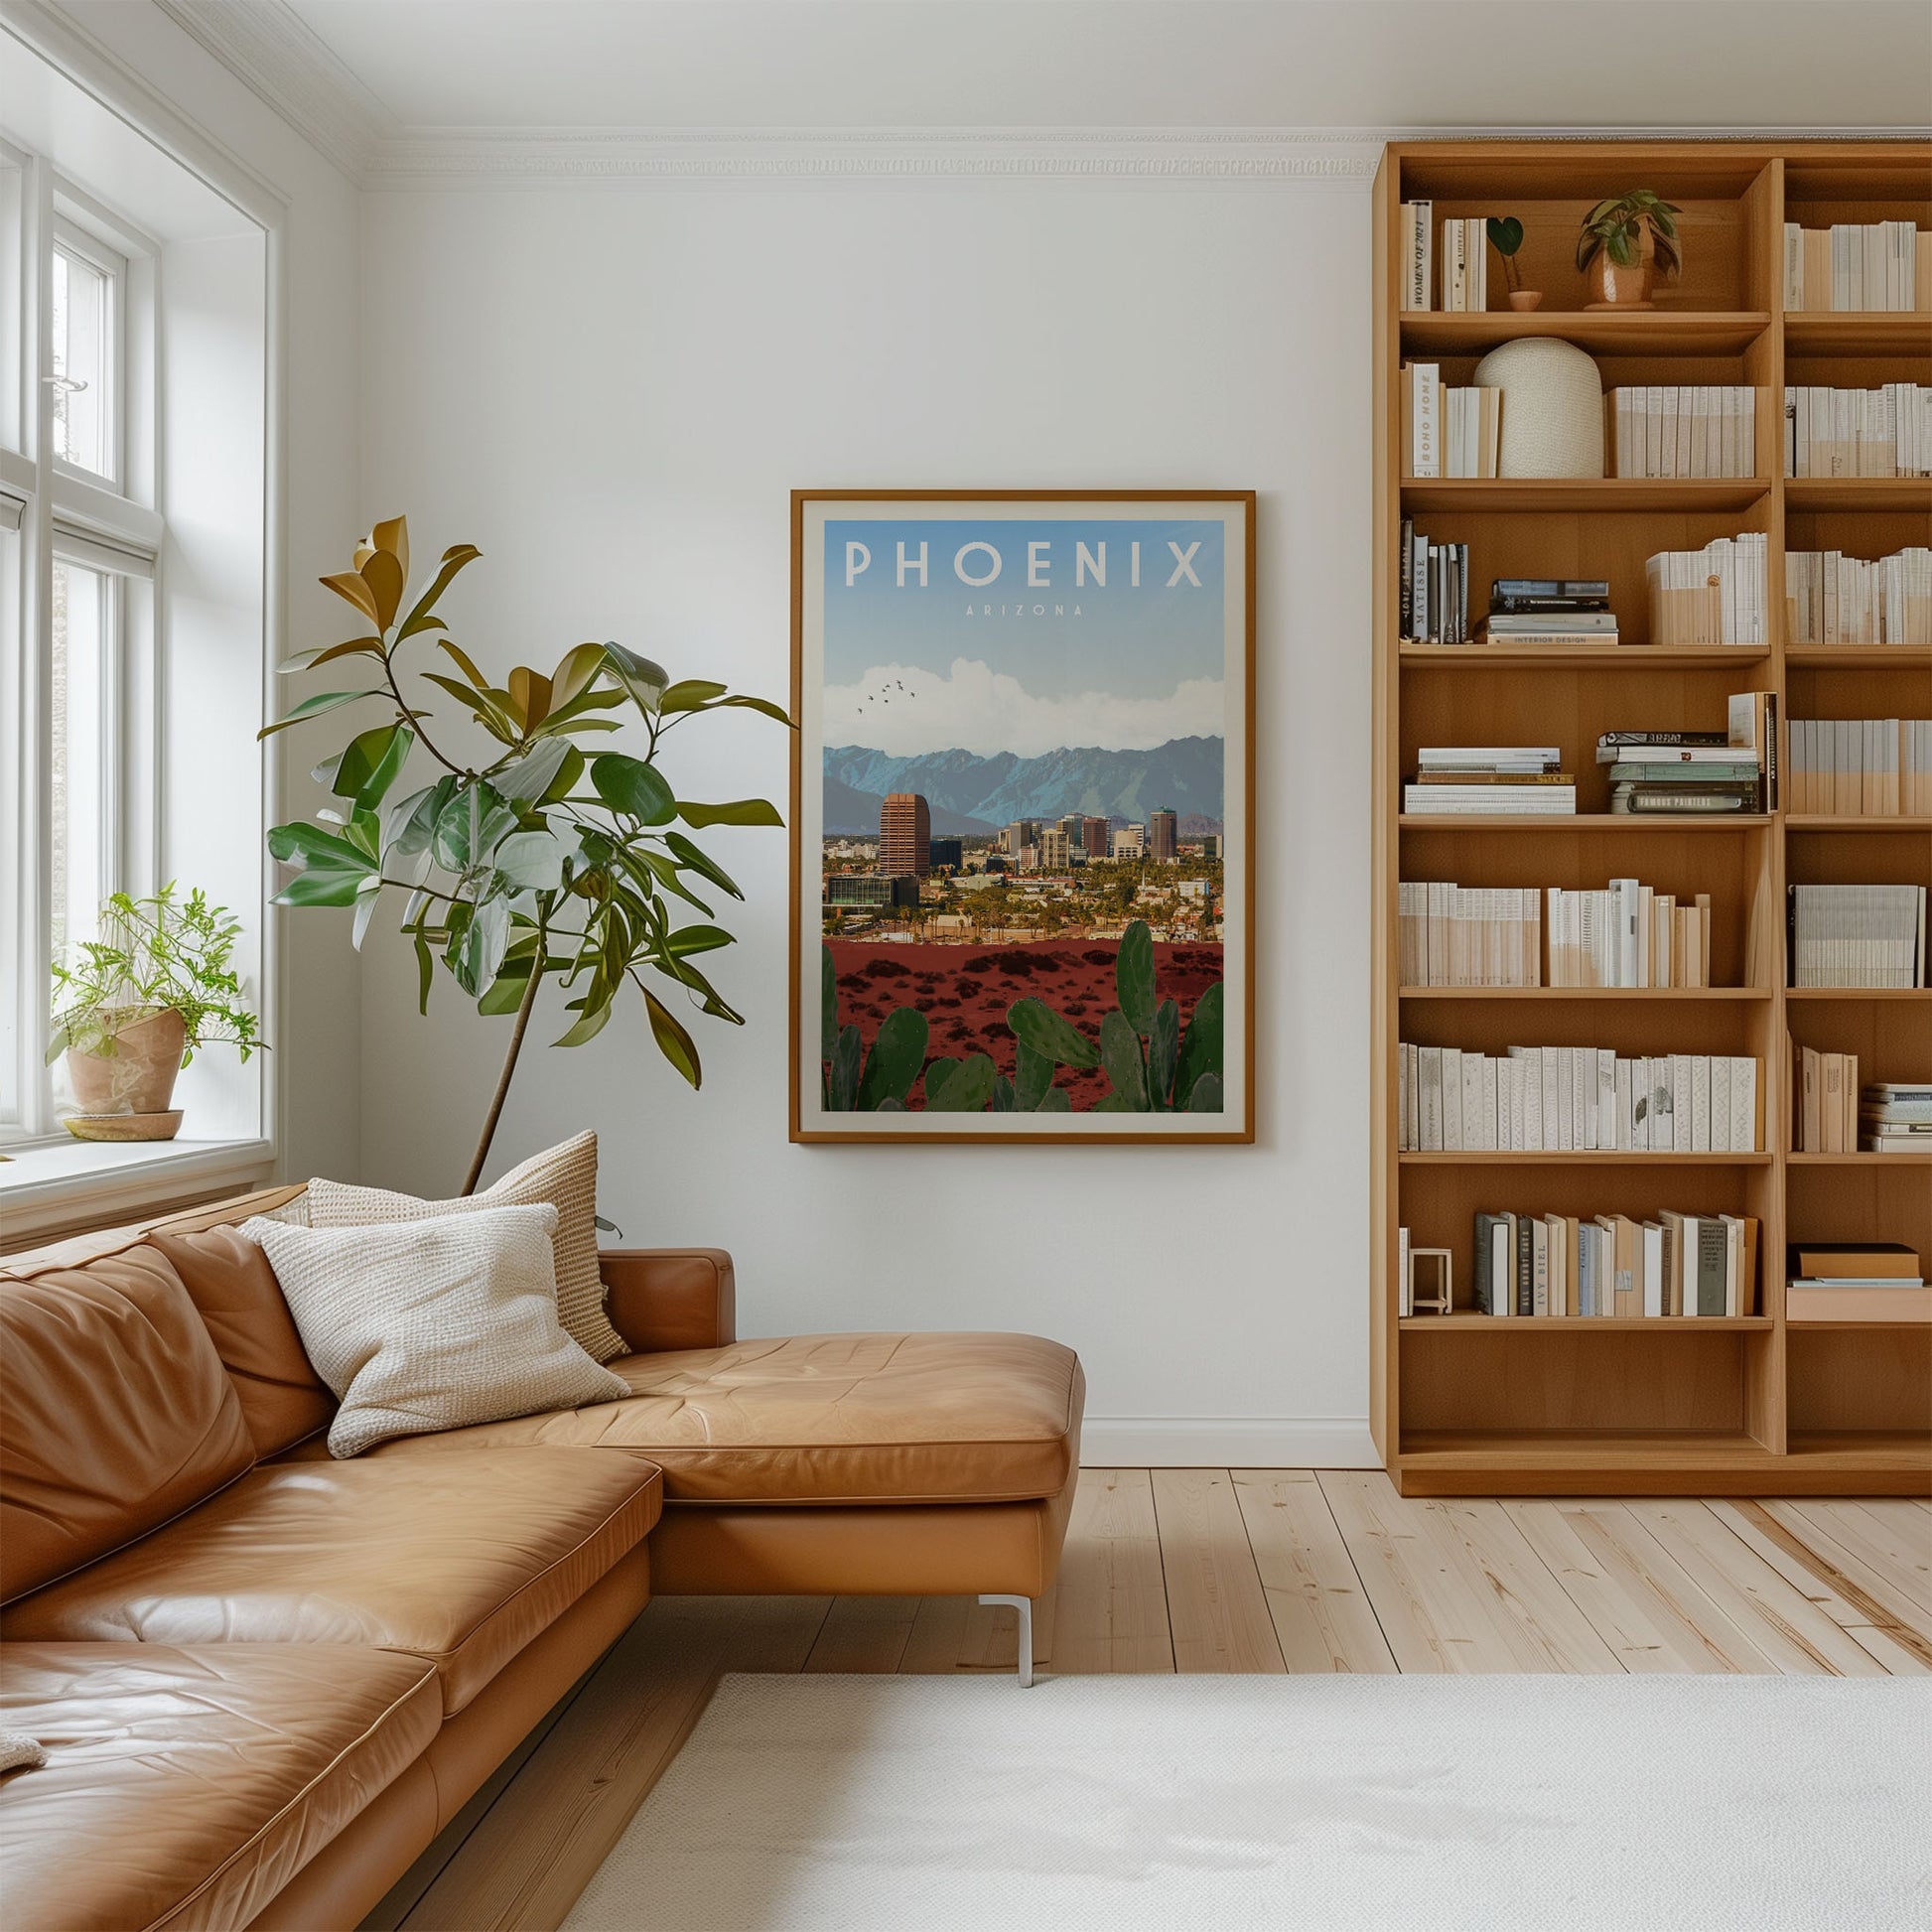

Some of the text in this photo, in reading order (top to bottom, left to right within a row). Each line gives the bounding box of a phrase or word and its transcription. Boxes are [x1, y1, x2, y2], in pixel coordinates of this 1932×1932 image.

[1415, 244, 1424, 260] OF
[1415, 262, 1424, 306] WOMEN
[1422, 422, 1431, 462] BOHO
[845, 541, 1202, 588] PHOENIX
[965, 605, 1083, 617] ARIZONA
